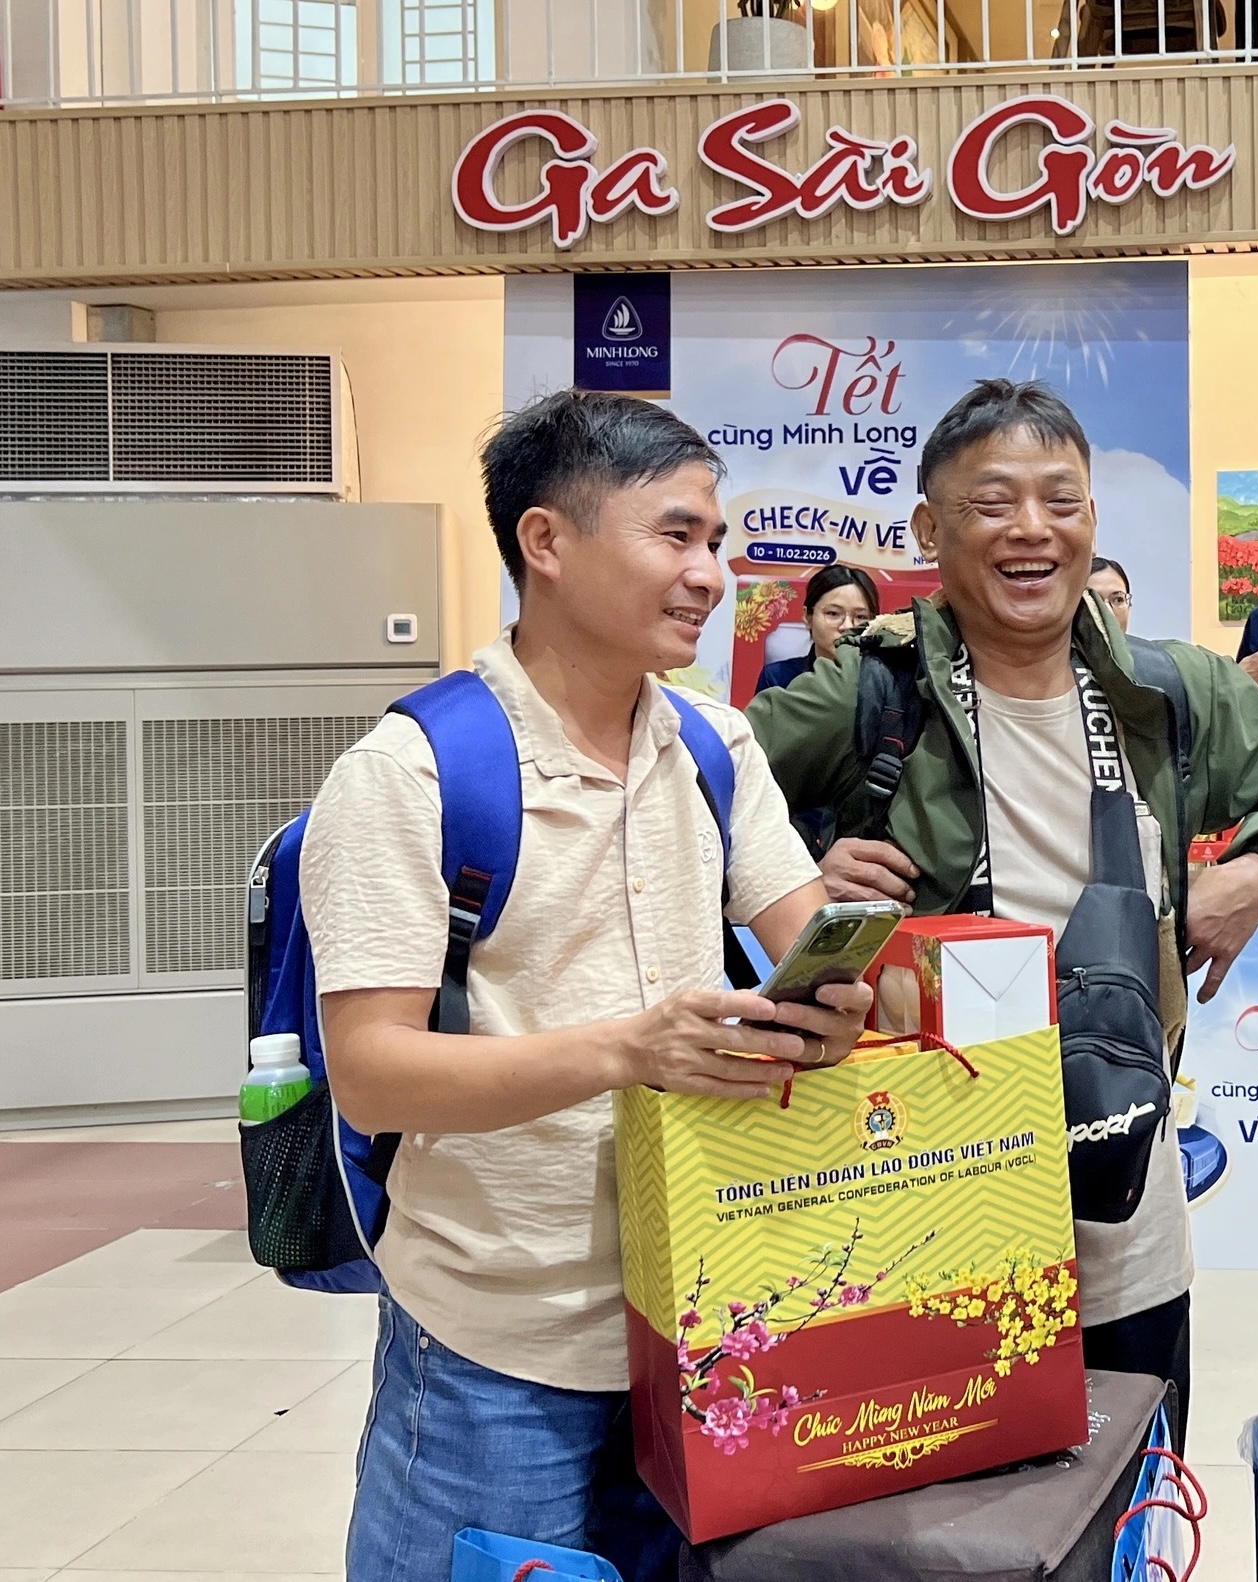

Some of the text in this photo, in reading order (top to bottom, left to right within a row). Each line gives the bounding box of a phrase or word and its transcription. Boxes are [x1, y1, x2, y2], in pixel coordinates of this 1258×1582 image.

[452, 94, 1237, 249] Ga Sài Gòn
[772, 333, 906, 416] Tết
[708, 423, 917, 451] cùng Minh Long
[839, 447, 901, 495] về
[743, 506, 908, 549] CHECK-IN VÉ
[753, 546, 765, 557] 10
[776, 547, 830, 560] 11.02.2026
[1066, 1102, 1156, 1153] port
[716, 1131, 1034, 1203] TỔNG LIÊN ĐOÀN LAO ĐỘNG VIỆT NAM
[716, 1153, 1037, 1222] VIETNAM GENERAL CONFEDERATION OF LABOUR (VGCL)
[794, 1411, 842, 1446] Chúc
[845, 1399, 903, 1435] Mừng
[907, 1385, 951, 1421] Năm
[842, 1416, 959, 1454] HAPPY NEW YEAR
